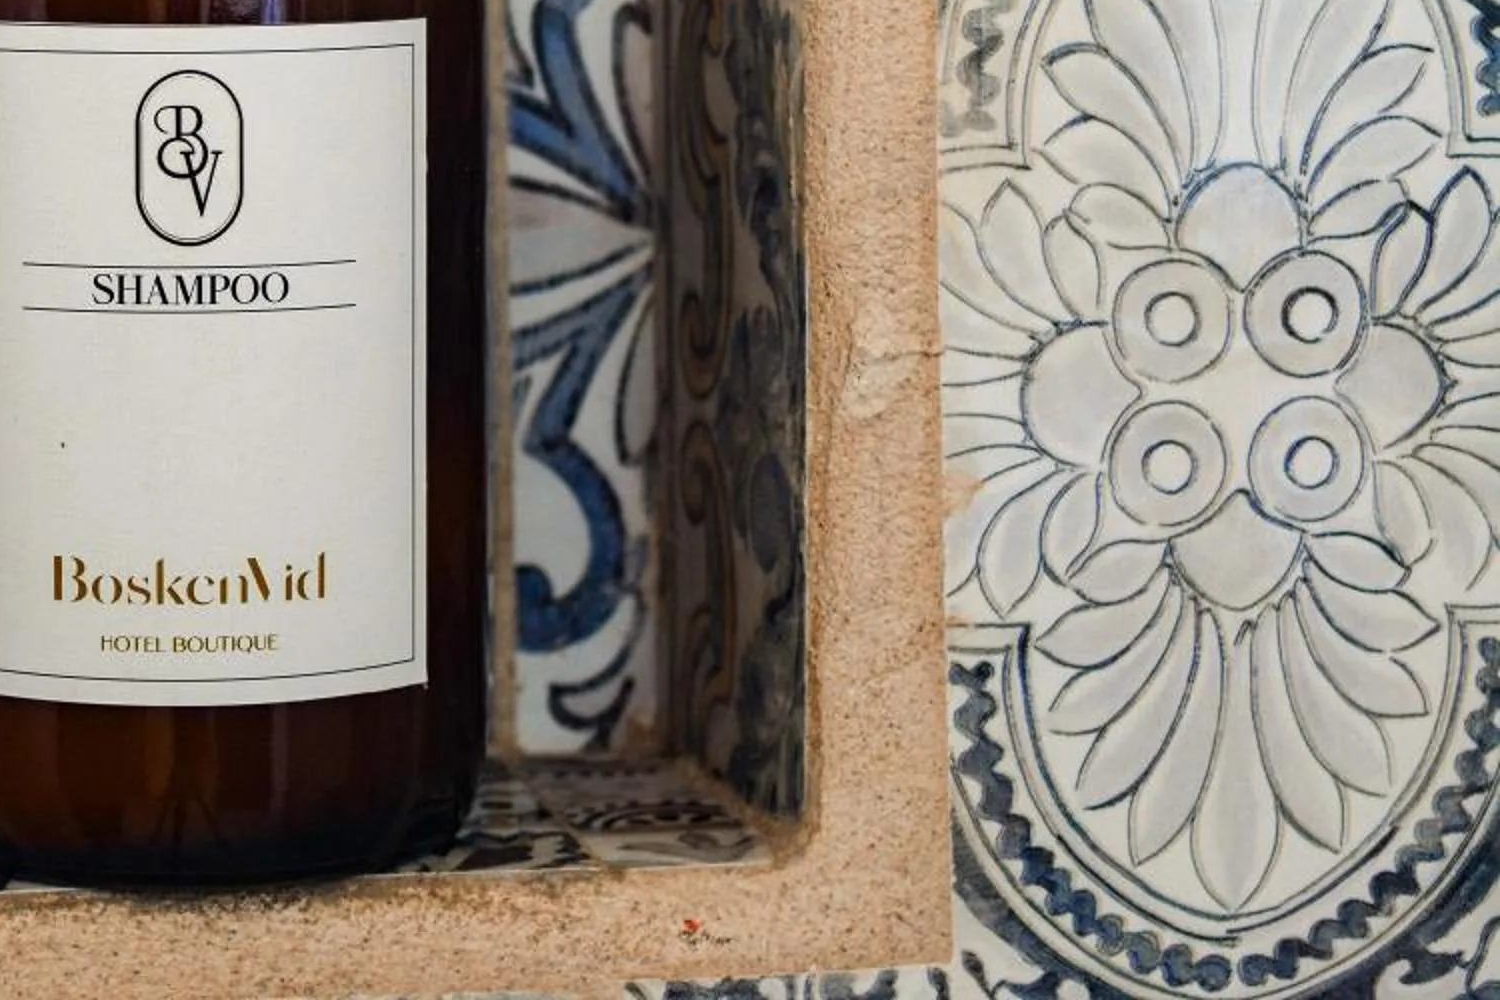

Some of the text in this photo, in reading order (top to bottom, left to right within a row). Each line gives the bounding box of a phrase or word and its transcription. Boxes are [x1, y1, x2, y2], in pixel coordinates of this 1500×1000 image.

[92, 271, 291, 306] SHAMPOO
[52, 551, 327, 606] BoskenVid
[100, 633, 280, 655] HOTEL BOUTIQUE
